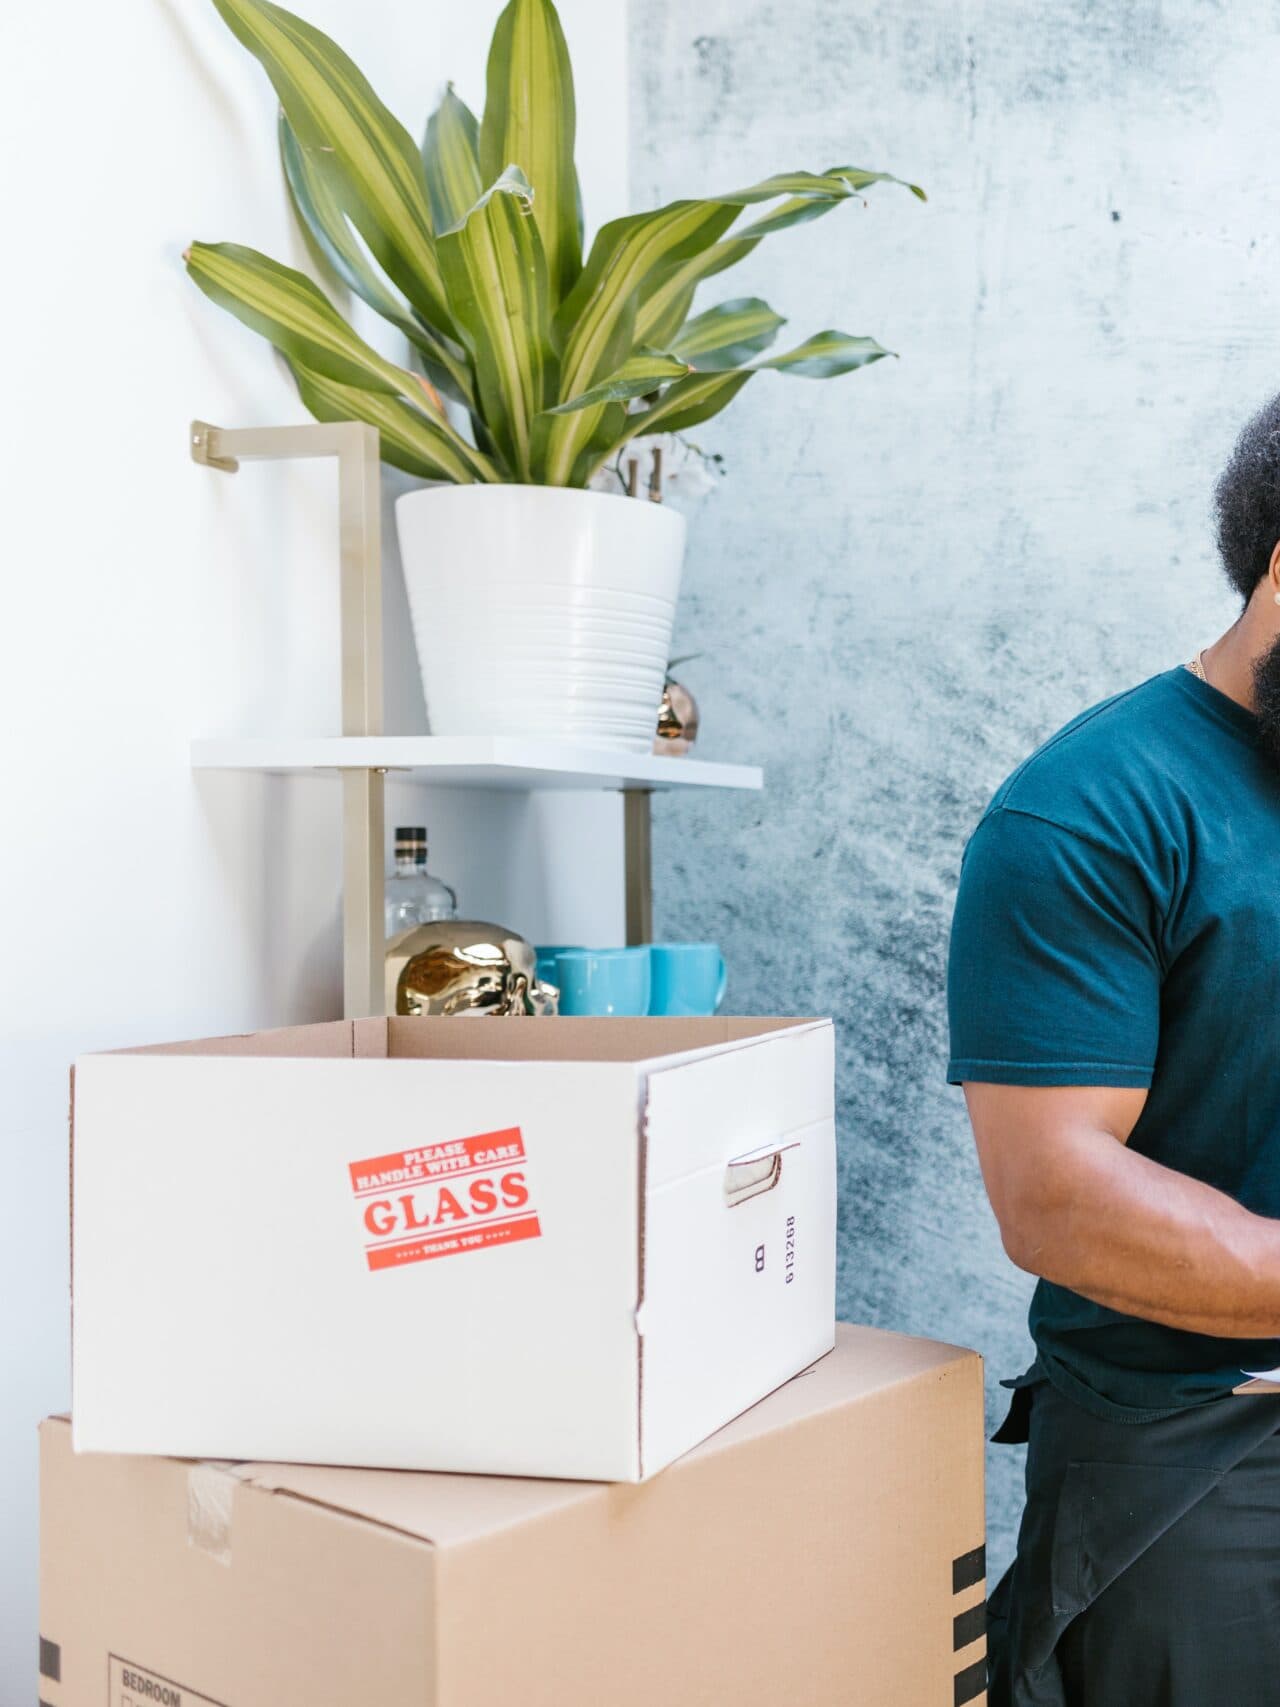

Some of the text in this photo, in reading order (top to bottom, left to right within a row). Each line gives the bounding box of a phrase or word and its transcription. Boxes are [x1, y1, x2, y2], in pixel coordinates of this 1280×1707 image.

[357, 1144, 519, 1190] HANDLE WITH CARE
[404, 1142, 466, 1165] PLEASE
[364, 1172, 529, 1235] GLASS
[423, 1233, 484, 1254] THANK YOU
[785, 1216, 795, 1284] 613268
[122, 1668, 181, 1707] BEDROOM
